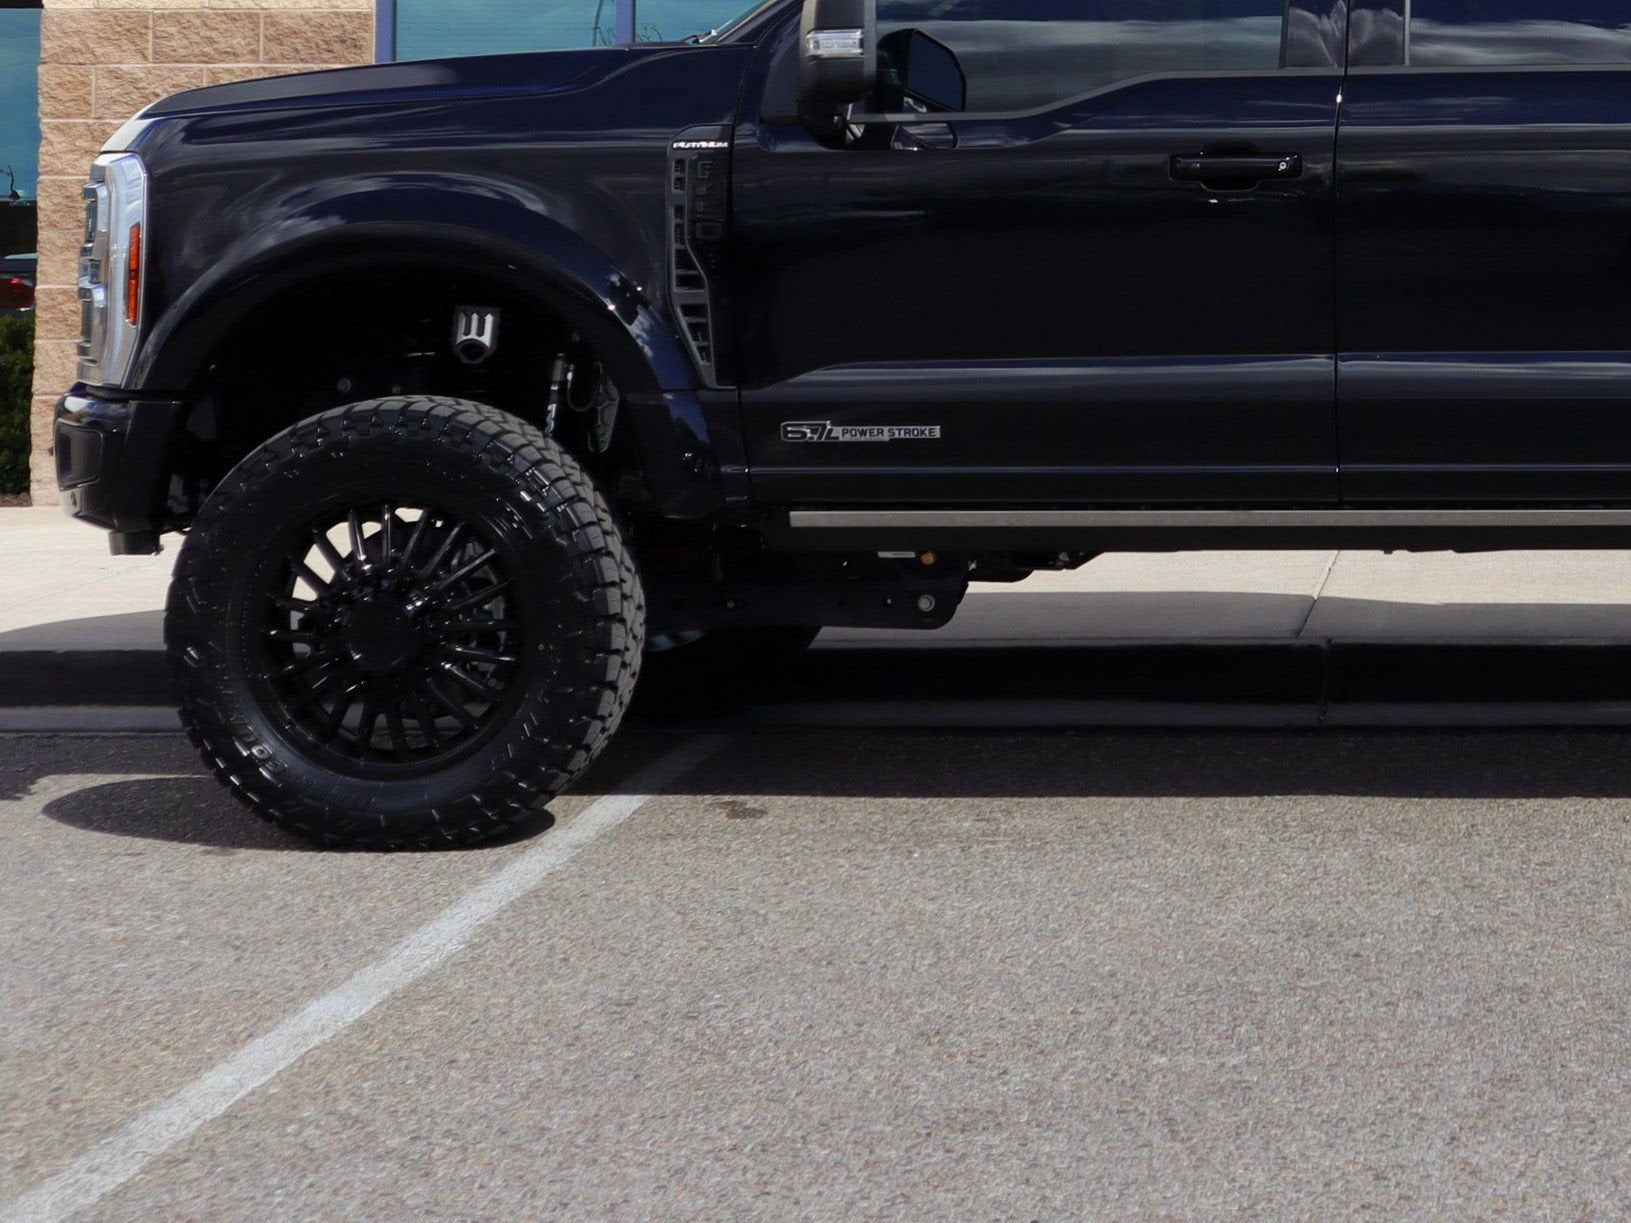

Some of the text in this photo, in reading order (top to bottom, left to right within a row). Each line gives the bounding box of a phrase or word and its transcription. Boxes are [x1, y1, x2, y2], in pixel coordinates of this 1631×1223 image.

[672, 140, 729, 149] PLATINUM
[781, 421, 937, 442] 6.7L POWER STROKE
